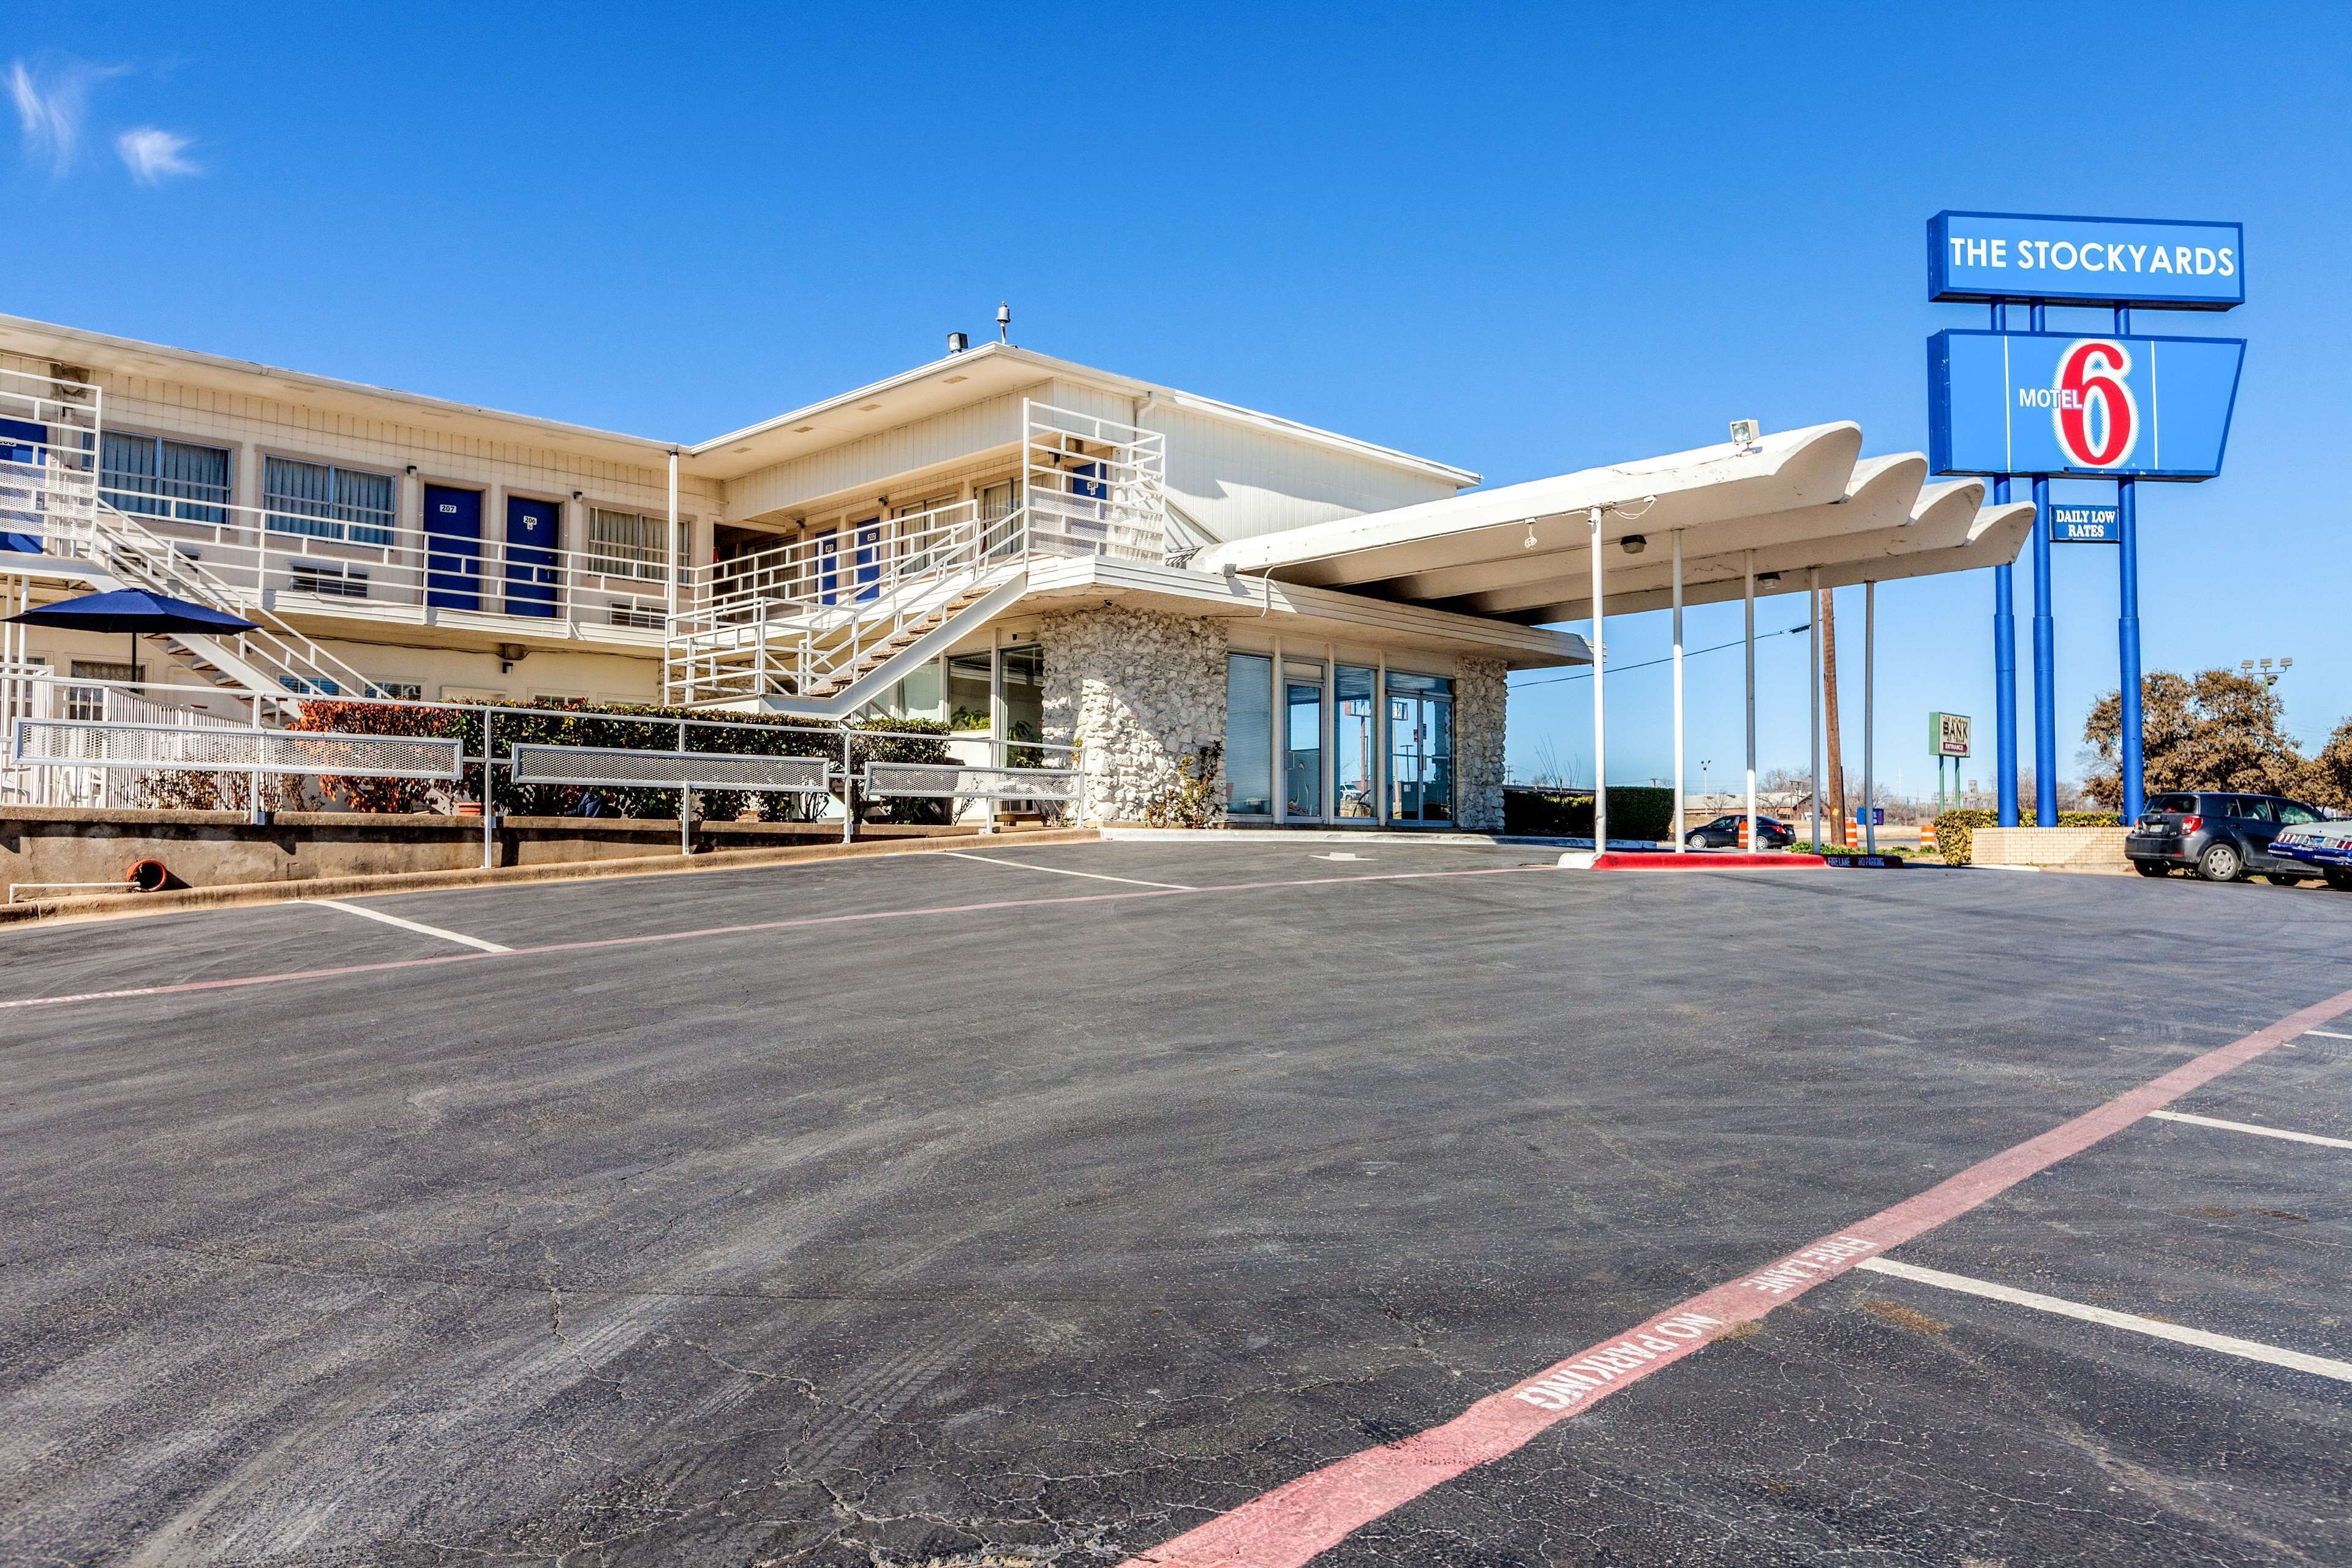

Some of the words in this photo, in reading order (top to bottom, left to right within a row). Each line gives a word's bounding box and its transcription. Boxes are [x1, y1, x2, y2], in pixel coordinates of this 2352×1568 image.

[1950, 237, 2007, 268] THE
[2017, 239, 2234, 276] STOCKYARDS
[2019, 388, 2083, 409] MOTEL
[2060, 342, 2132, 466] 6
[2056, 510, 2090, 523] DAILY
[2091, 510, 2116, 523] LOW
[2068, 524, 2105, 537] RATES
[1943, 722, 1968, 739] BANK
[1945, 743, 1964, 752] ENTRANCE
[1828, 858, 1838, 867] FIRE
[1839, 858, 1851, 867] LANE
[1858, 858, 1865, 866] NO
[1866, 858, 1885, 867] PARKING
[1800, 1236, 1878, 1264] FIRE
[1739, 1259, 1828, 1294] LANE
[1655, 1312, 1724, 1338] NO
[1513, 1333, 1679, 1409] PARKING
